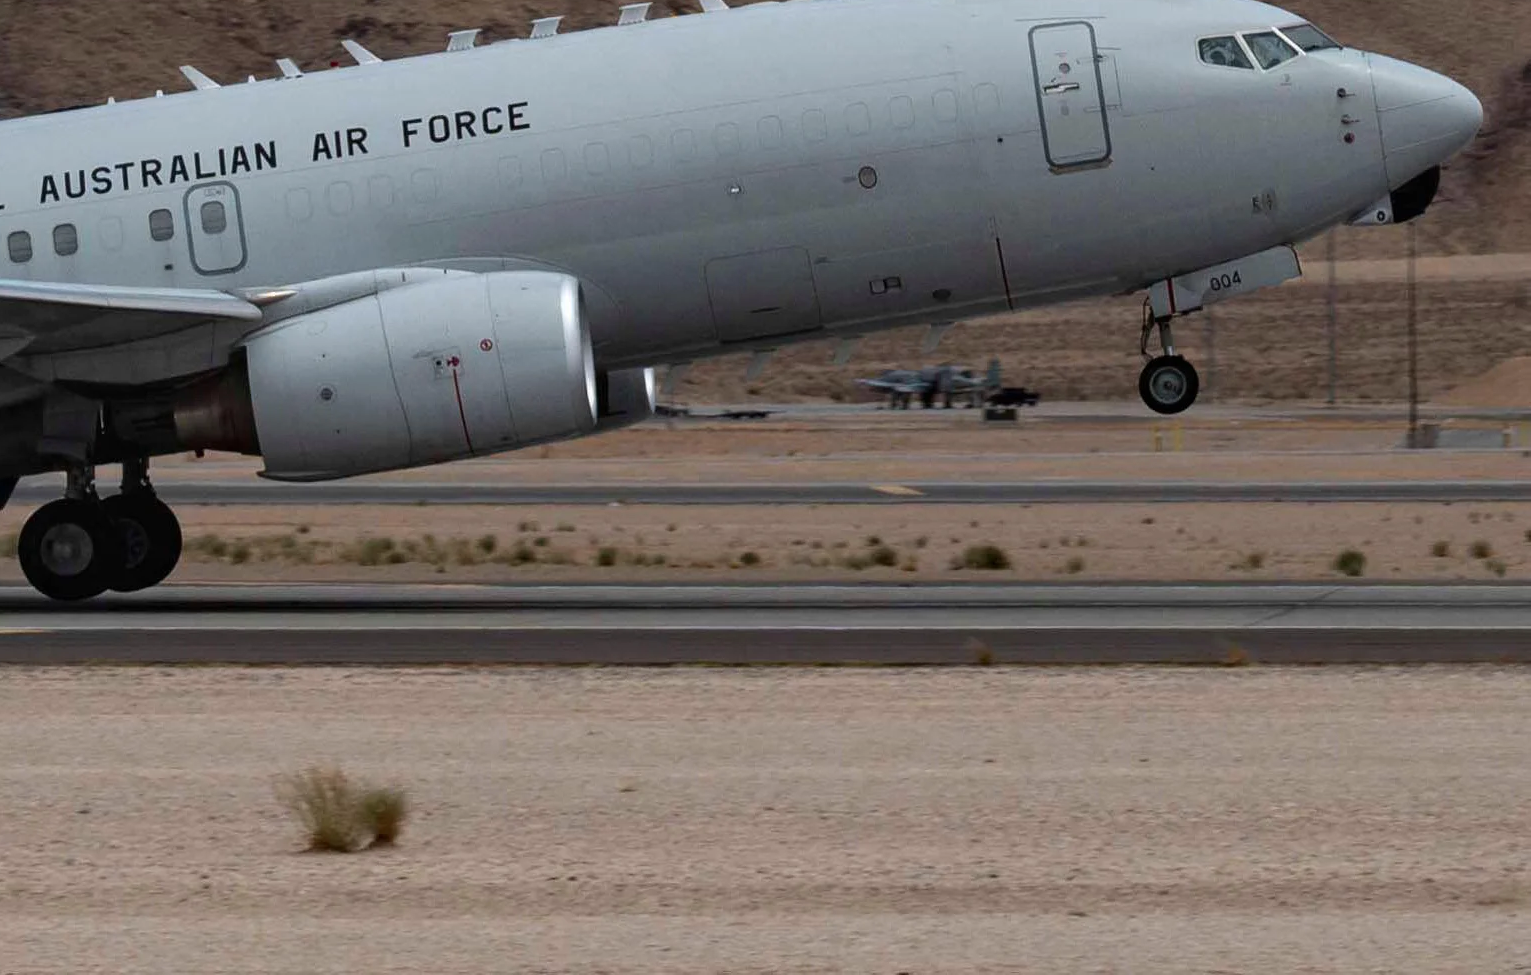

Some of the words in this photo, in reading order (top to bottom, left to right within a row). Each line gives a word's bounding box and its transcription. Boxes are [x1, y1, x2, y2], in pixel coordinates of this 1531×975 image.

[40, 140, 277, 204] AUSTRALIAN
[312, 127, 368, 162] AIR
[402, 101, 530, 148] FORCE
[1210, 270, 1242, 292] 004
